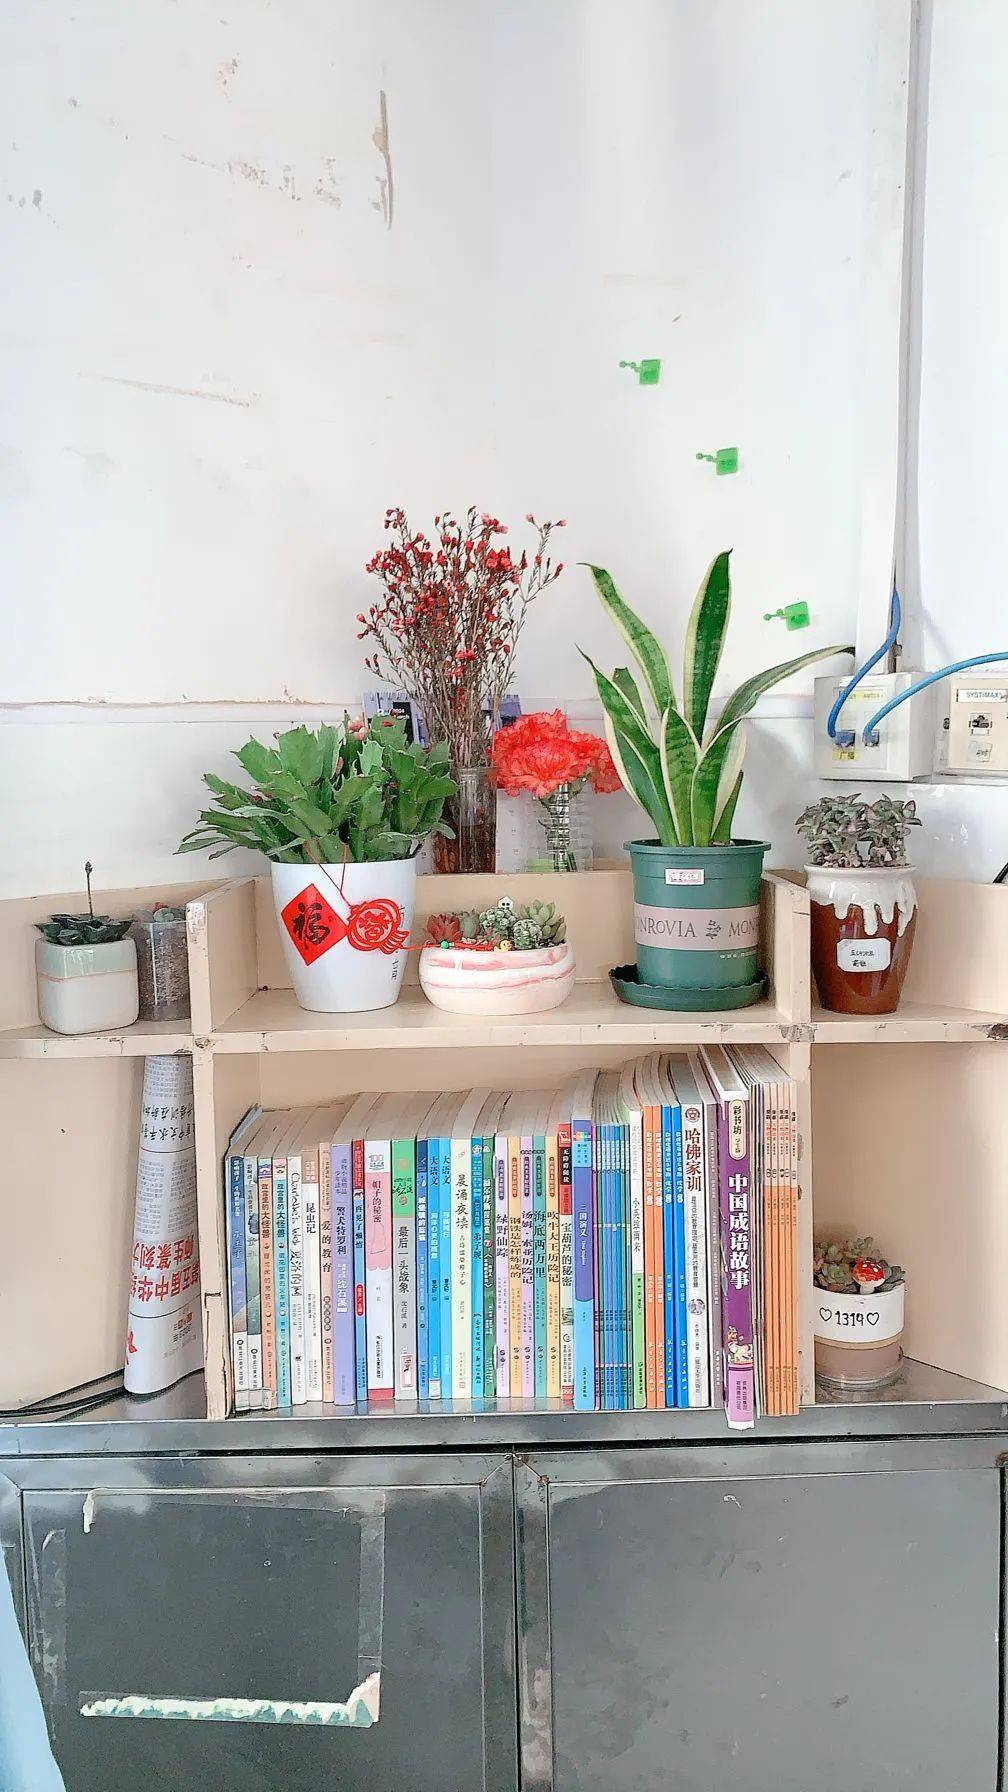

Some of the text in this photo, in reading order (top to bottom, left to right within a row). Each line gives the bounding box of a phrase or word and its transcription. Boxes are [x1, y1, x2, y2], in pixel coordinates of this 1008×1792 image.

[292, 902, 330, 950] 福
[430, 1156, 438, 1186] 大语文
[442, 1156, 450, 1185] 大语文
[685, 1128, 702, 1191] 哈佛家训
[306, 1203, 316, 1234] 昆虫记
[372, 1180, 382, 1223] 帽子的秘密
[455, 1174, 468, 1229] 晨诵夜读
[321, 1220, 332, 1273] 爱的教育
[496, 1214, 508, 1257] 绿野仙踪
[510, 1217, 521, 1279] 钢铁是怎样炼成的
[534, 1211, 546, 1278] 海底两万里
[547, 1212, 559, 1283] 吹牛大王历险记
[561, 1222, 572, 1287] 宝葫芦的秘密
[728, 1173, 750, 1290] 中国成语故事
[398, 1226, 409, 1293] 最后一头战象
[835, 1311, 864, 1326] 1314
